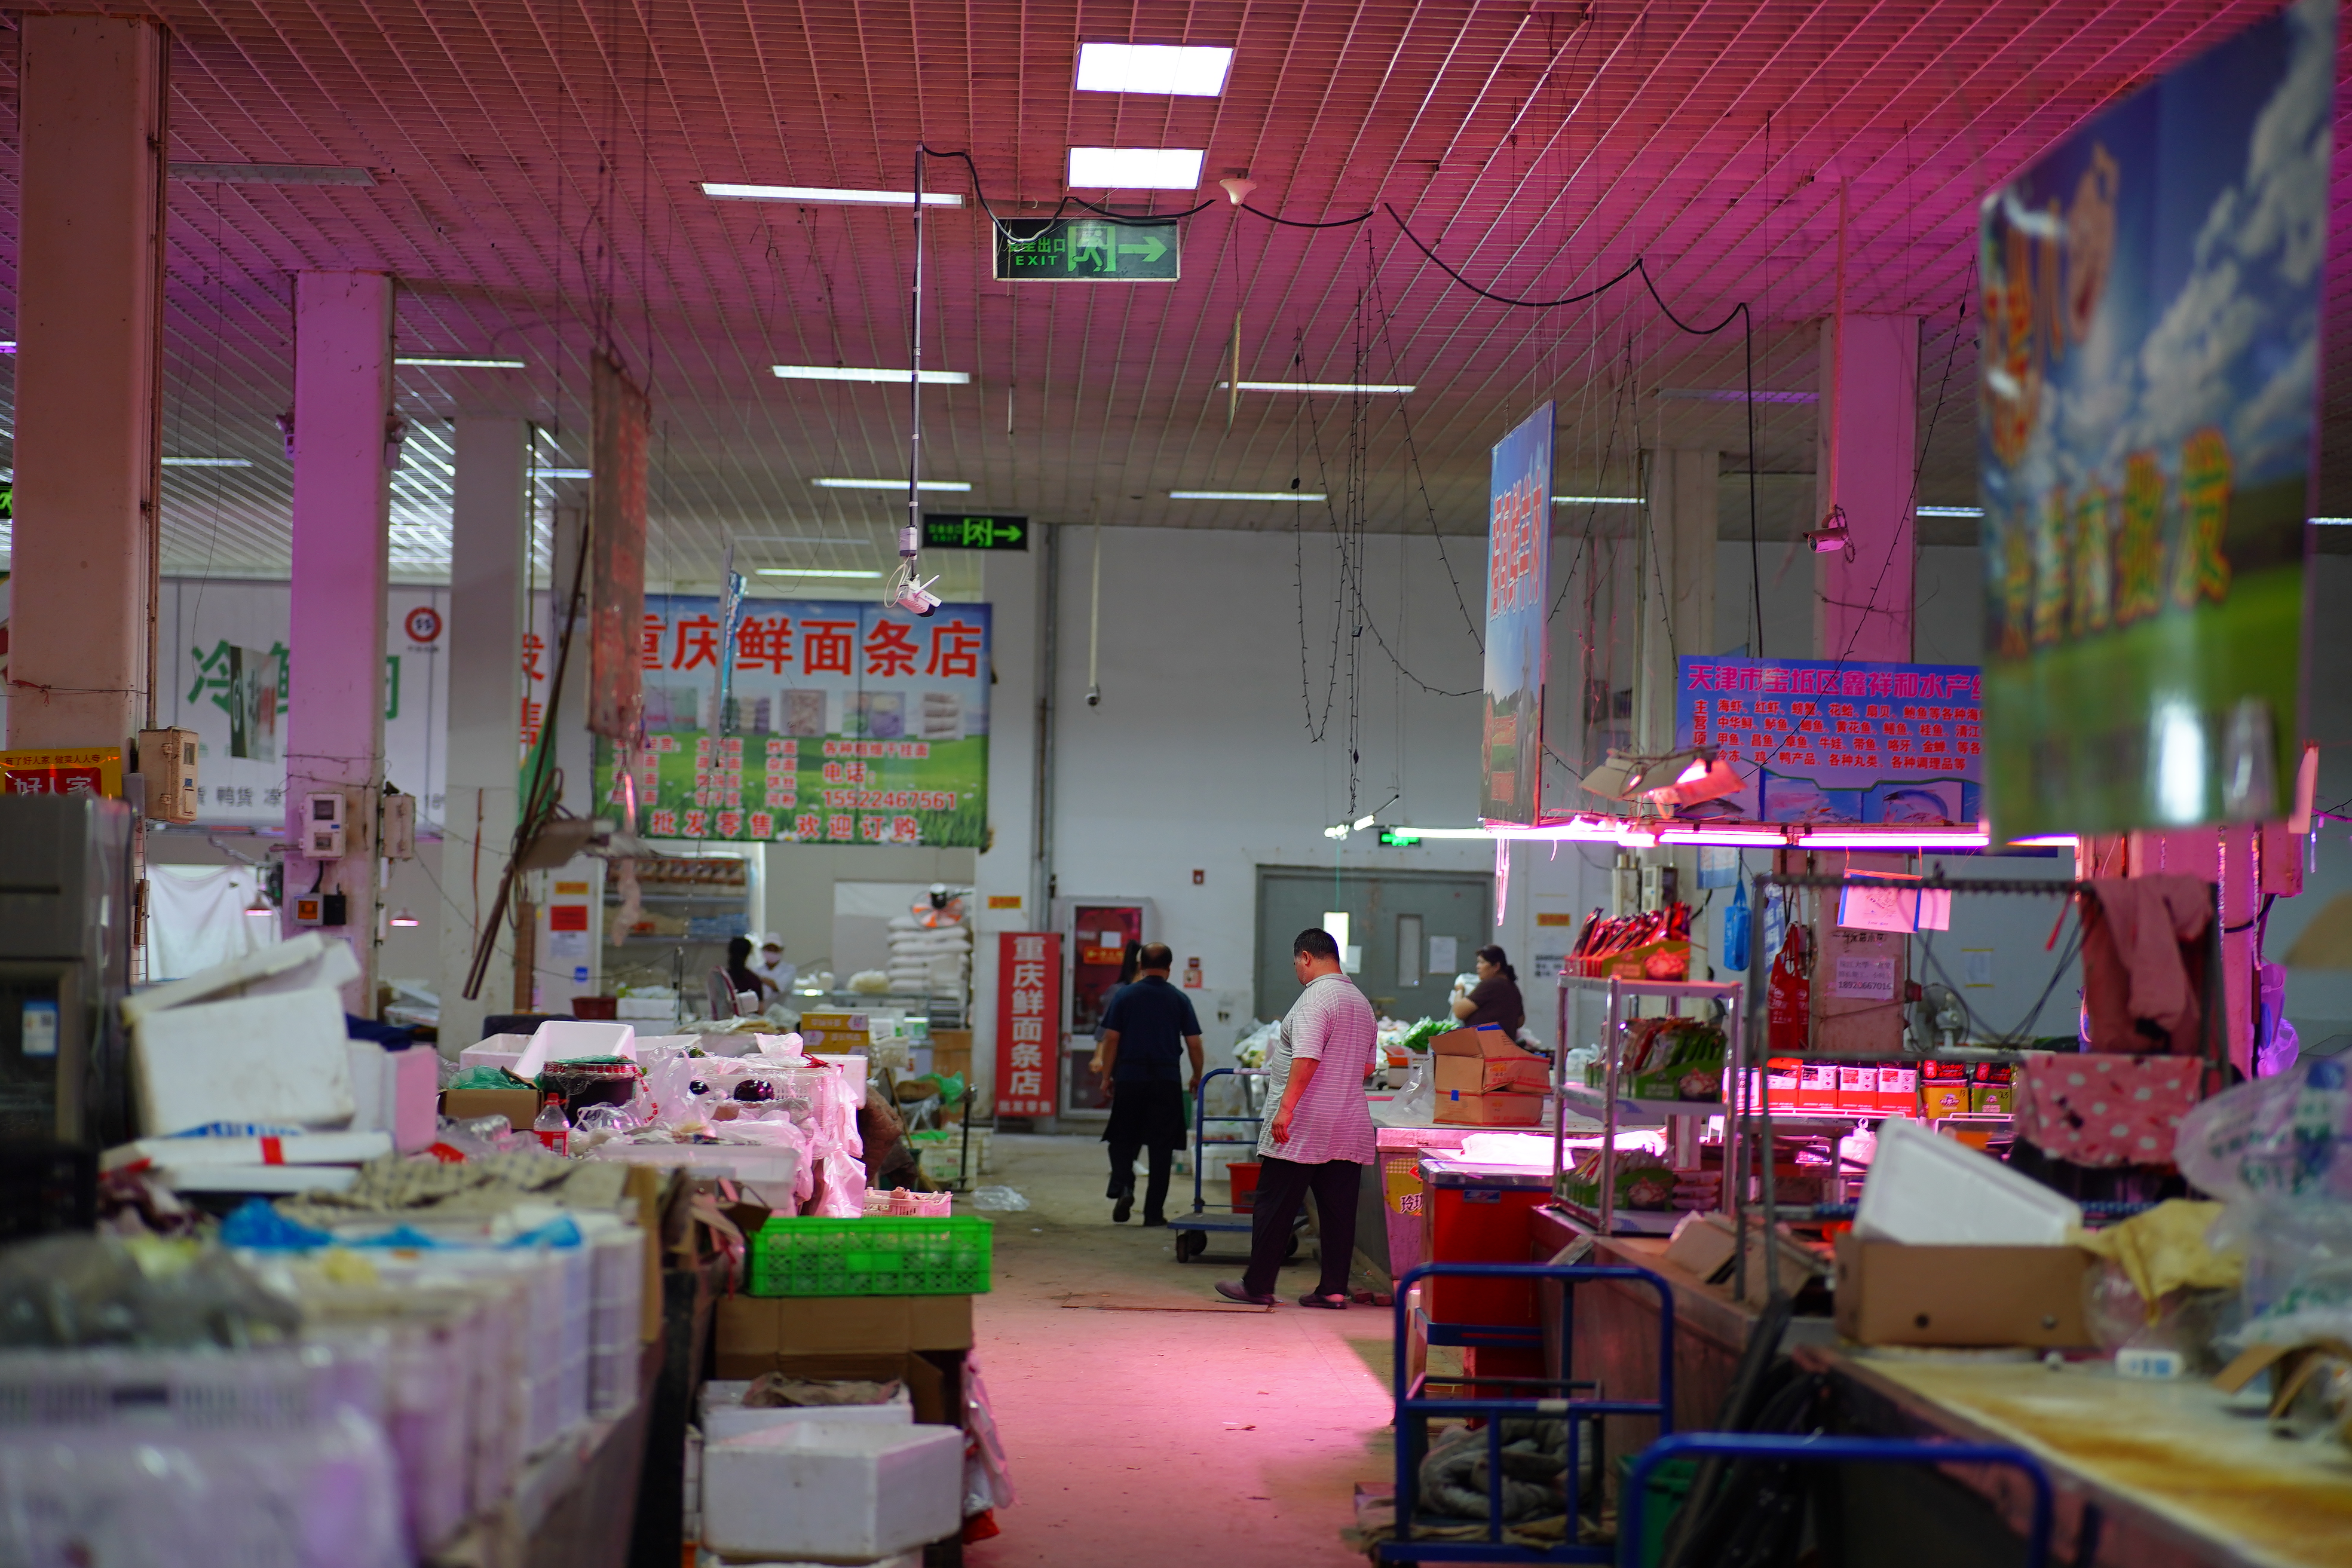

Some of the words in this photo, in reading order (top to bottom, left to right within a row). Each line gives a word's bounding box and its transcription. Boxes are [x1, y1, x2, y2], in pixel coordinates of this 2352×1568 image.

[1016, 255, 1058, 265] EXIT
[1693, 699, 1708, 747] 主营项
[823, 790, 957, 811] 15522467561
[651, 809, 774, 838] 批发零售
[796, 814, 918, 841] 欢迎订购
[1009, 935, 1046, 1097] 重庆鲜面条店
